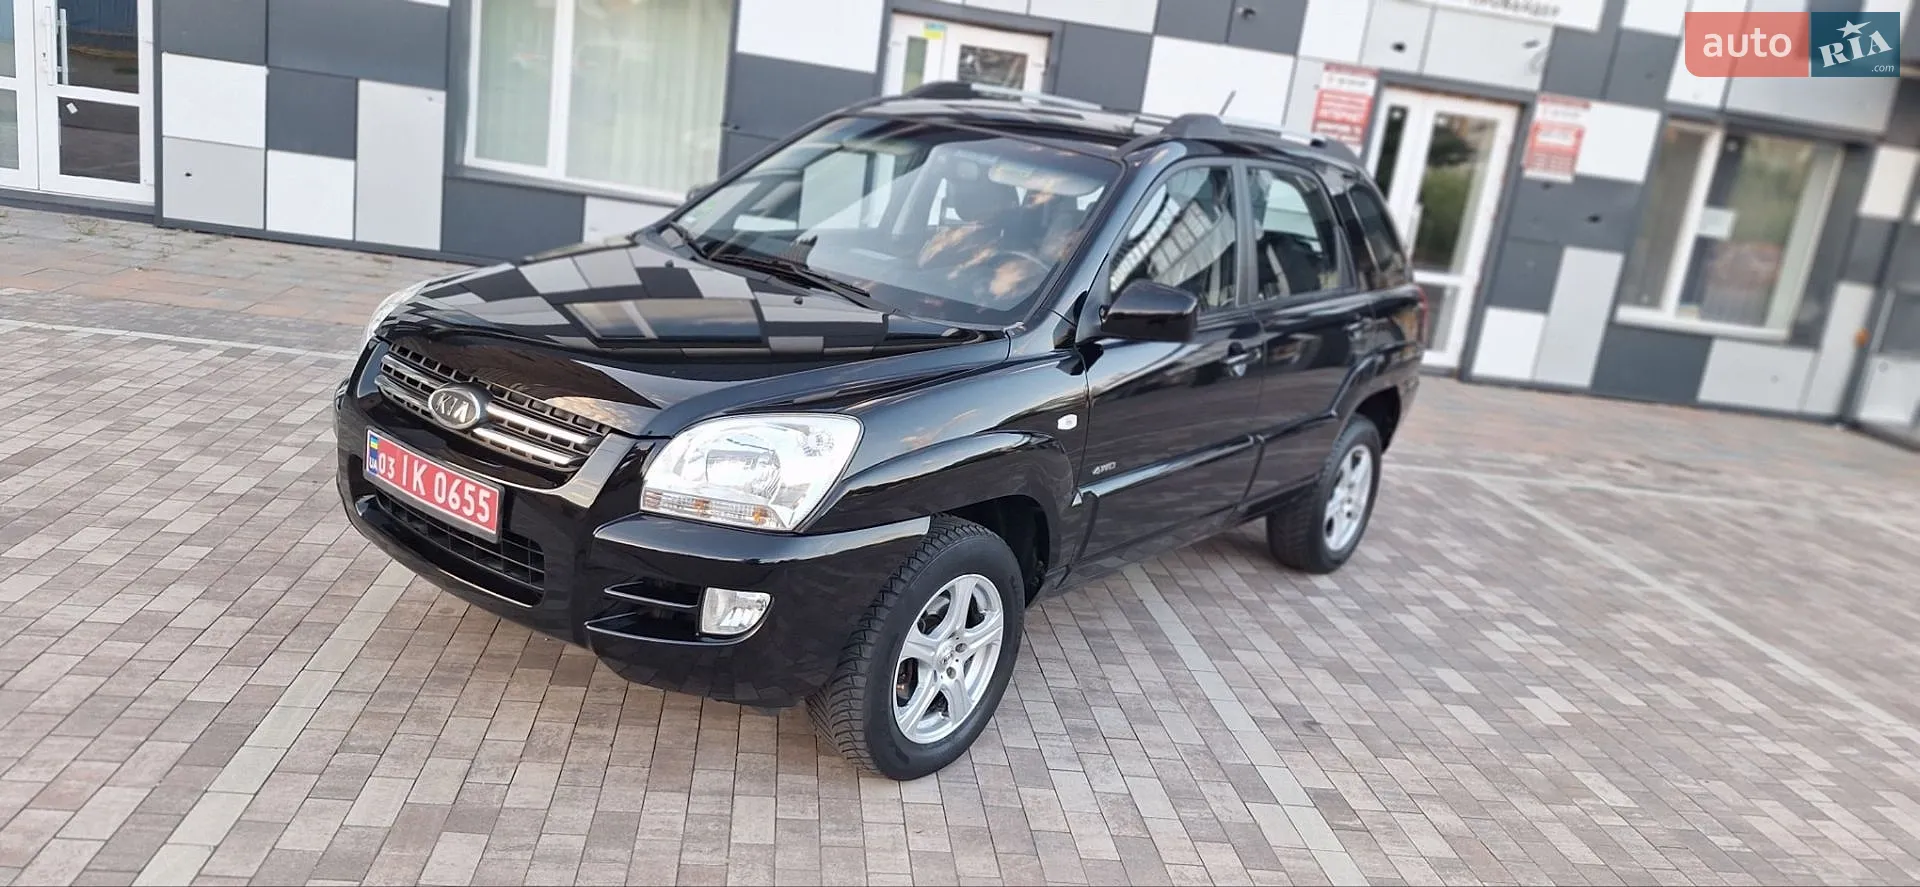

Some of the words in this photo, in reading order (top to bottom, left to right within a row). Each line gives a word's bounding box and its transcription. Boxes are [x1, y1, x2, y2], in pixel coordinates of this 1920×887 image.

[435, 392, 470, 423] KIA
[368, 456, 378, 470] UA
[1092, 461, 1117, 475] 4WD
[378, 452, 396, 480] 03
[402, 454, 427, 496] IK
[433, 471, 491, 523] 0655
